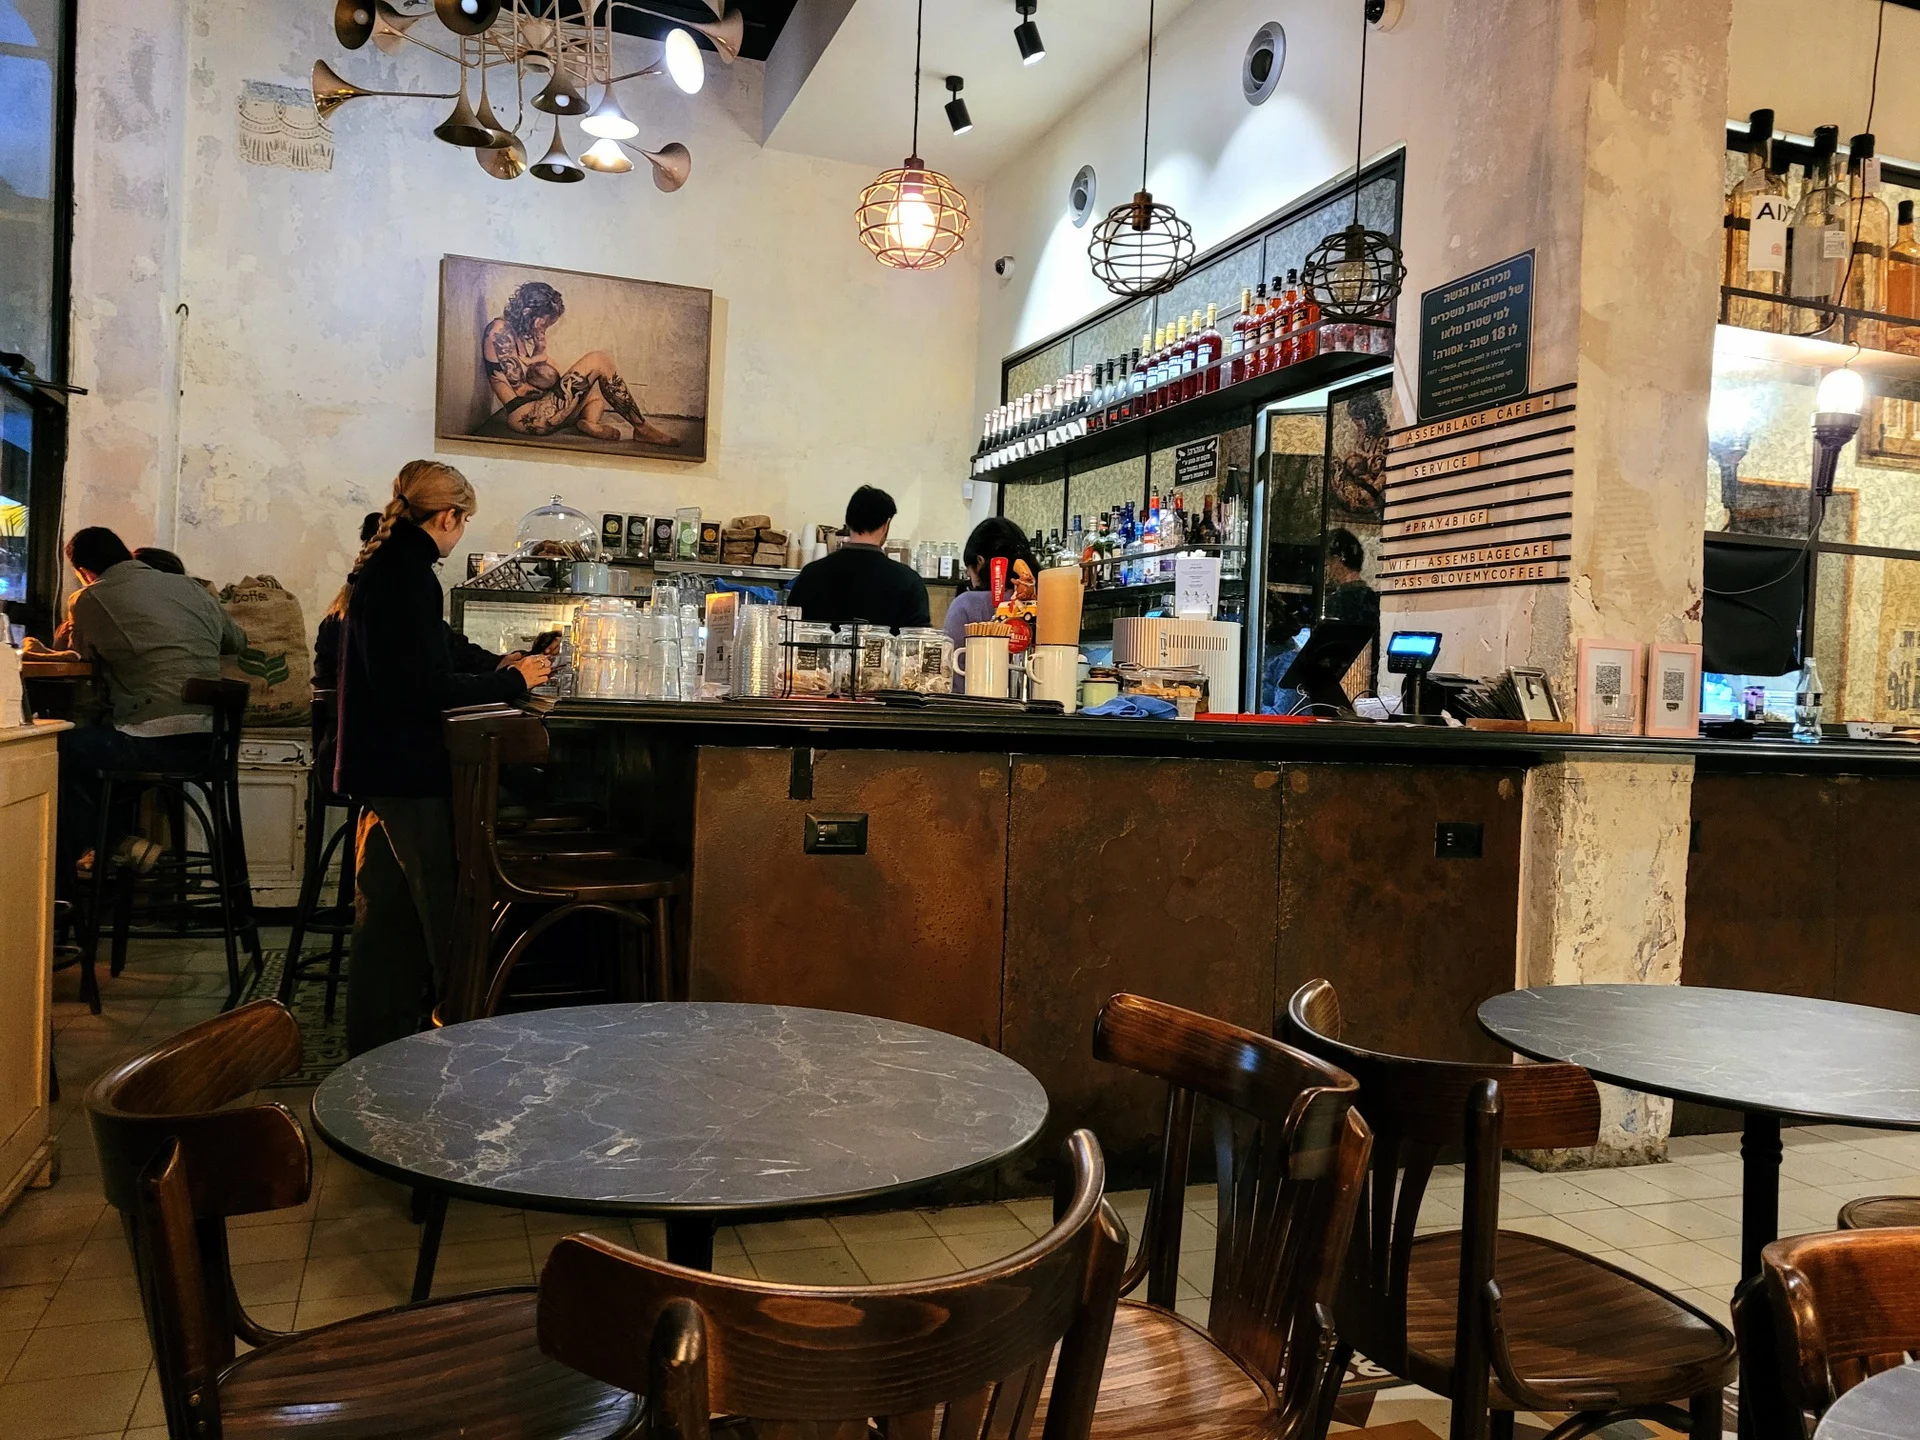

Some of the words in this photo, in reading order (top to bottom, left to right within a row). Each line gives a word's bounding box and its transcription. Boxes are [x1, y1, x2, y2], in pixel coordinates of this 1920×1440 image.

[1470, 281, 1481, 293] או
[1482, 269, 1511, 289] מכירה
[1443, 286, 1469, 304] הגשה
[1508, 283, 1524, 297] של
[1466, 290, 1507, 313] משקאות
[1430, 306, 1465, 325] משכרים
[1493, 306, 1510, 321] למי
[1464, 314, 1491, 332] שטרם
[1507, 323, 1518, 337] לו
[1441, 325, 1462, 340] מלאו
[1469, 334, 1489, 349] שנה
[1491, 325, 1505, 341] 18
[1407, 413, 1486, 442] ASSEMBLAGE
[1497, 402, 1531, 420] CAFE
[1414, 456, 1467, 477] SERVICE
[1405, 511, 1484, 532] #PRAY4BIGF
